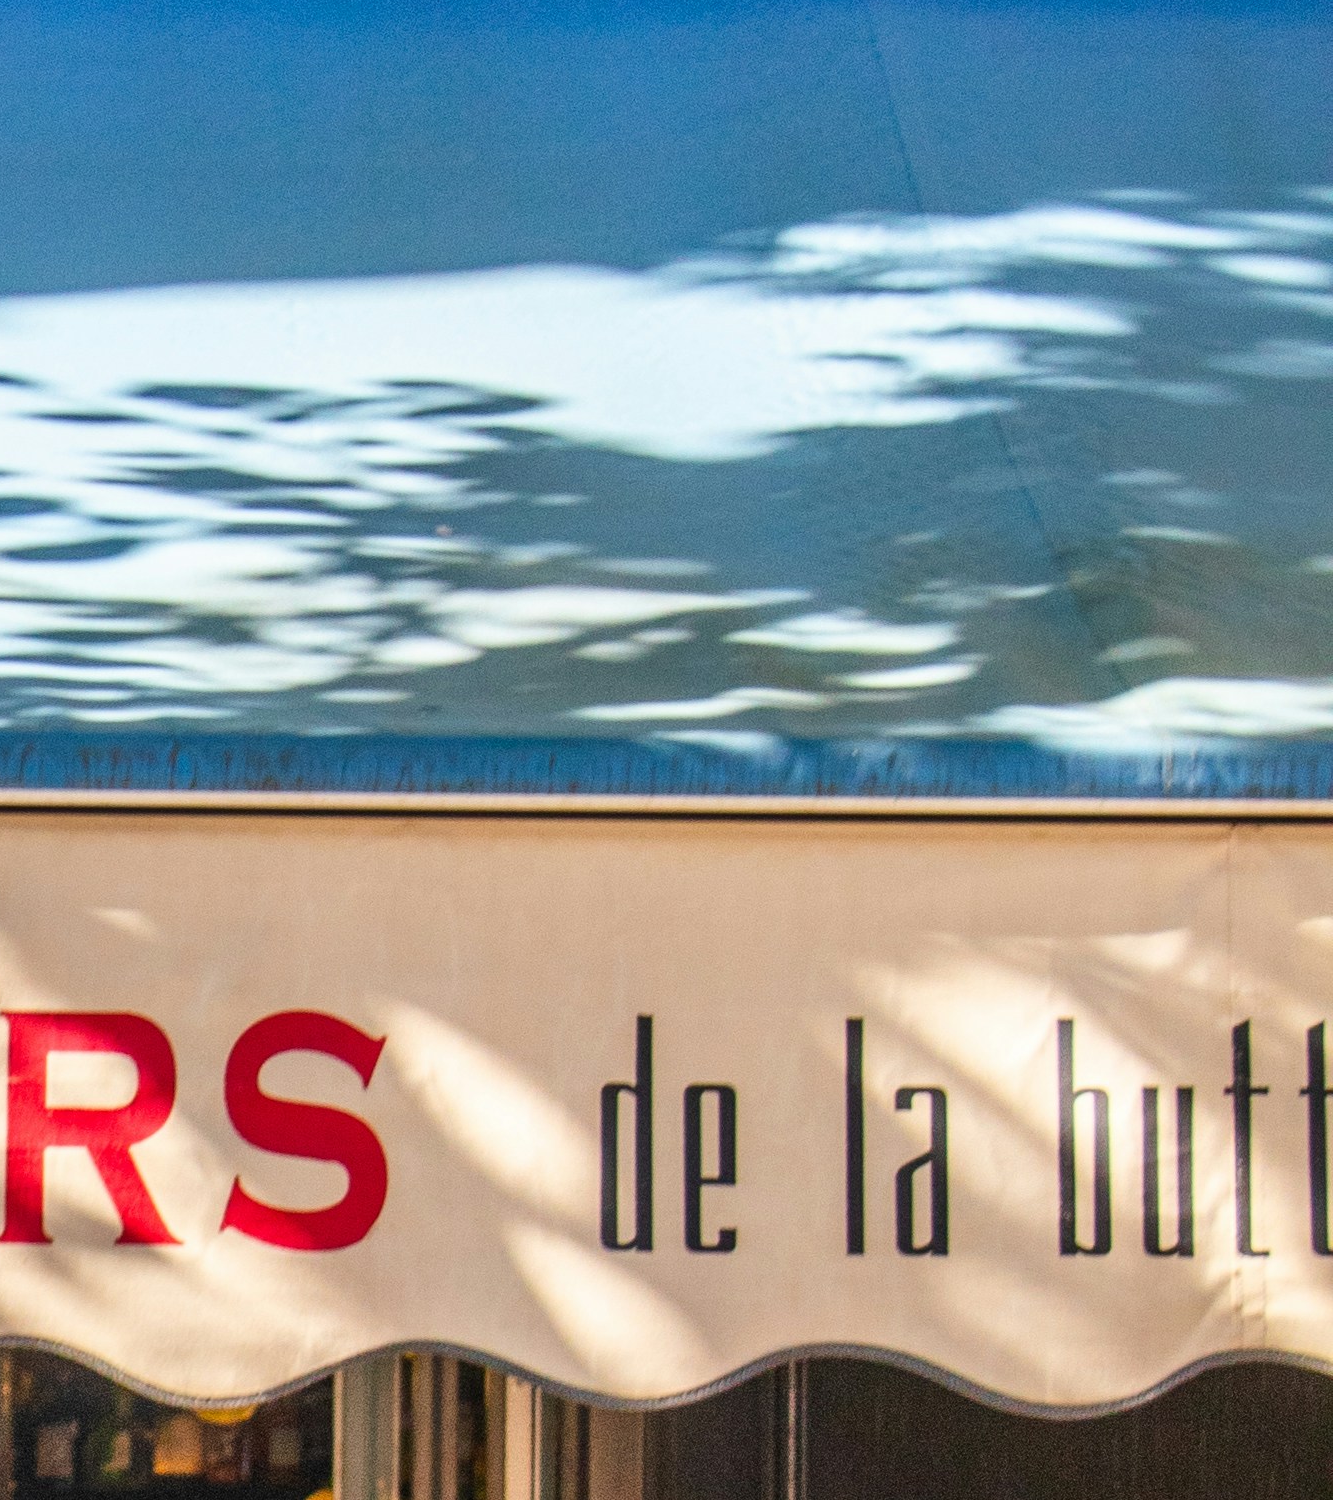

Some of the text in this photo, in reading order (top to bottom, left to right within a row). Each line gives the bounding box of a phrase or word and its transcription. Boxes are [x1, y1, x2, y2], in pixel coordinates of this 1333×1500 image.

[600, 1014, 737, 1253] de
[846, 1017, 949, 1257] la
[1057, 1017, 1333, 1258] butt
